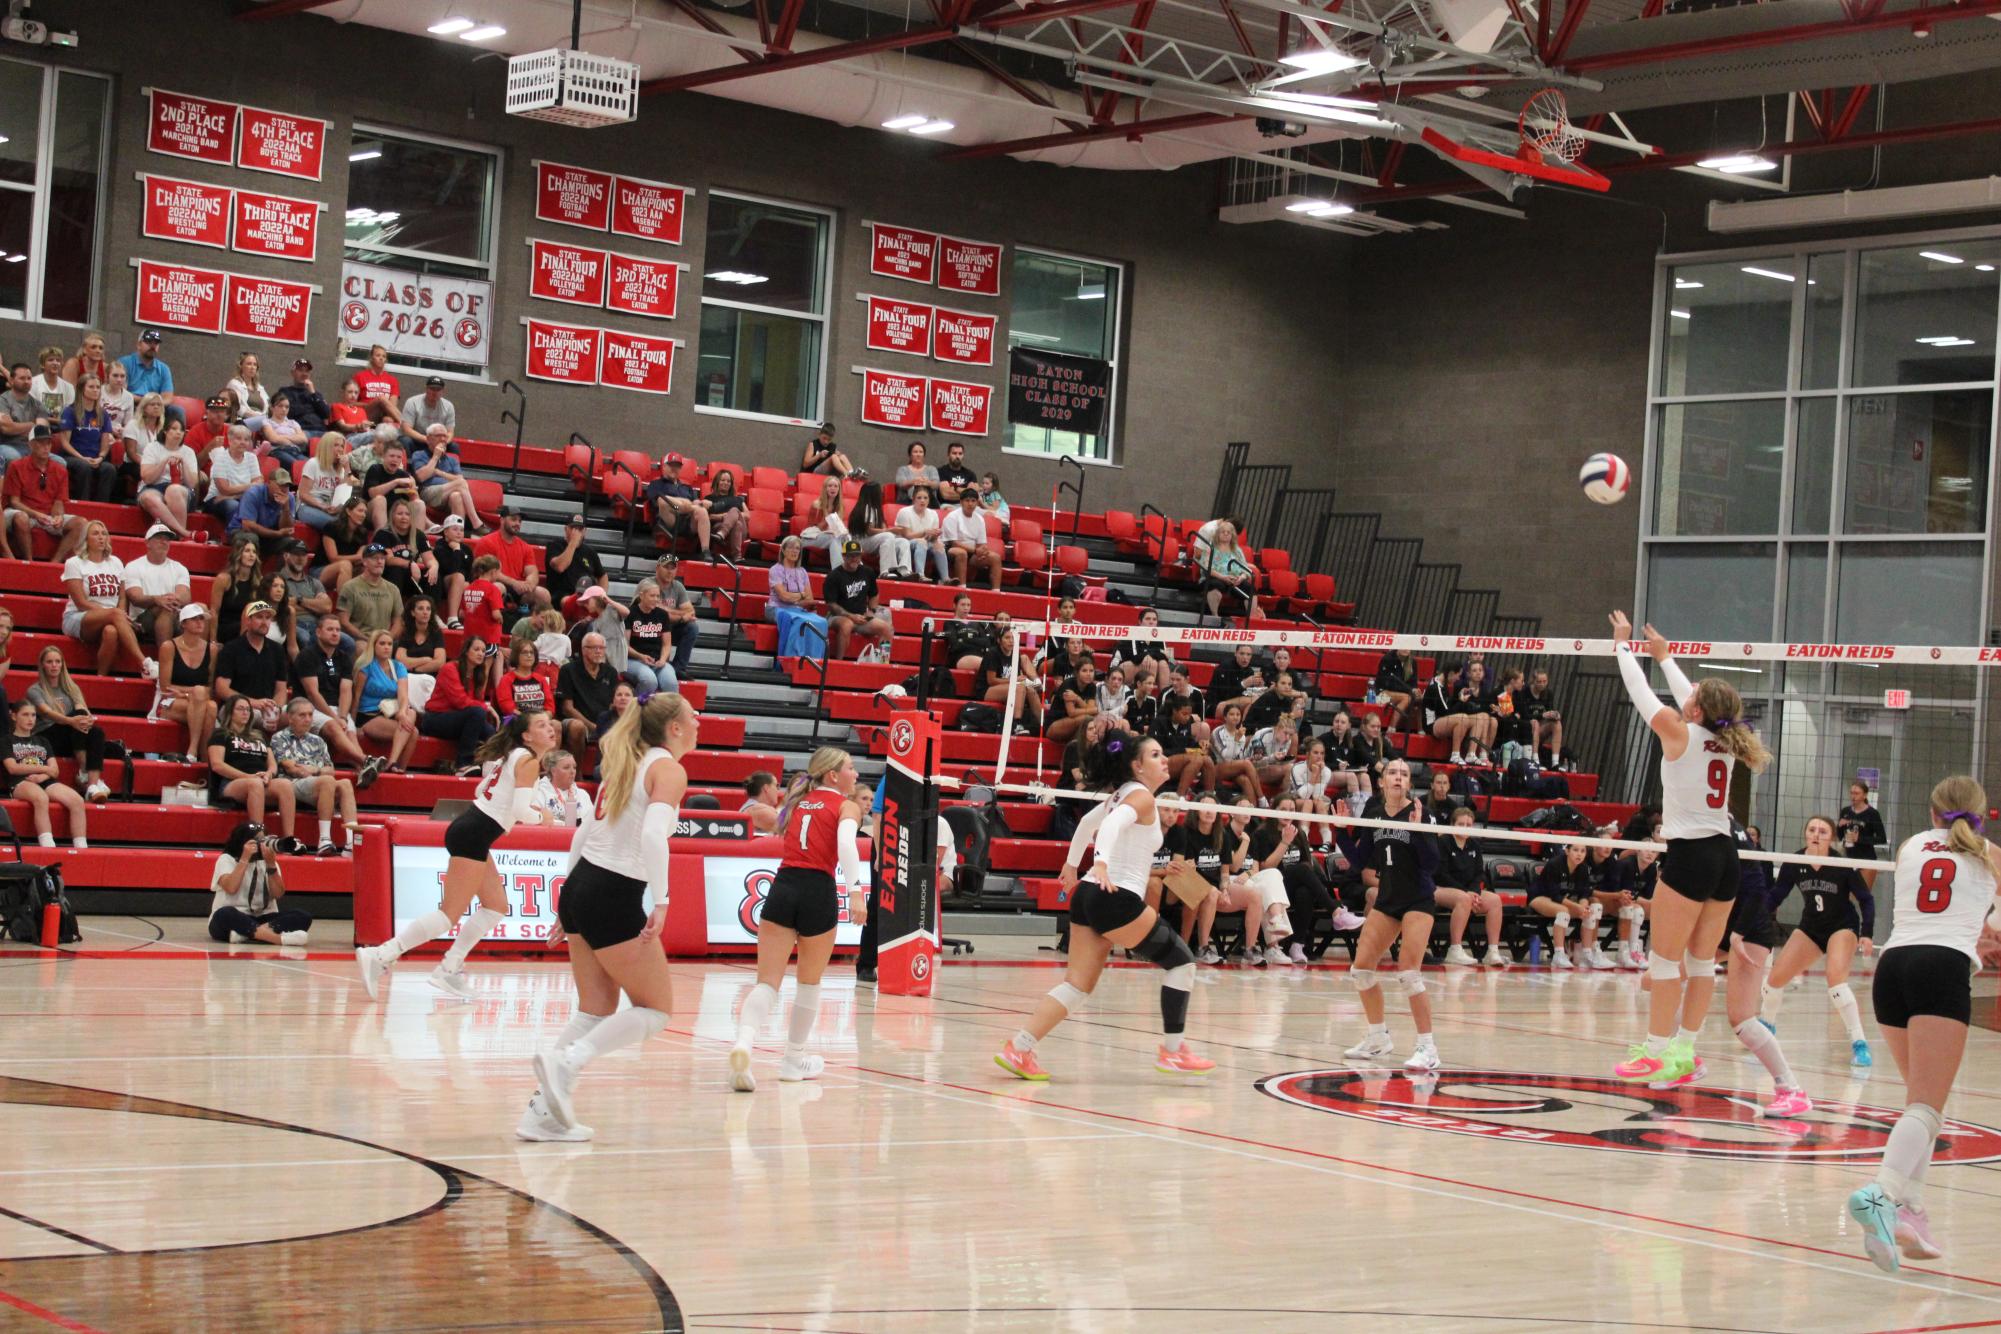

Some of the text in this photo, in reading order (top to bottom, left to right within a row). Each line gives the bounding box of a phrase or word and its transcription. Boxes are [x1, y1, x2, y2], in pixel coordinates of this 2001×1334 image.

[180, 102, 207, 114] STATE
[161, 104, 225, 133] 2ND PLACE
[272, 118, 296, 129] STATE
[176, 123, 207, 137] 2021 AA
[252, 122, 314, 149] 4TH PLACE
[162, 130, 218, 148] MARCHING BAND
[180, 142, 199, 153] EATON
[260, 148, 301, 162] BOYS TRACK
[271, 158, 290, 168] EATON
[565, 172, 588, 183] STATE
[176, 186, 202, 197] STATE
[548, 175, 602, 200] CHAMPIONS
[639, 188, 661, 198] STATE
[156, 188, 221, 216] CHAMPIONS
[266, 201, 291, 212] STATE
[559, 201, 588, 213] FOOTBALL
[622, 189, 675, 214] CHAMPIONS
[244, 203, 311, 230] THIRD PLACE
[565, 210, 582, 219] EATON
[632, 207, 663, 220] 2023 AAA
[168, 217, 207, 230] WRESTLING
[633, 216, 661, 228] BASEBALL
[176, 227, 196, 236] EATON
[639, 225, 654, 234] EATON
[248, 229, 303, 245] MARCHING BAND
[265, 241, 284, 250] EATON
[878, 234, 930, 258] FINAL FOUR
[962, 246, 981, 254] STATE
[559, 250, 581, 261] STATE
[947, 248, 994, 268] CHAMPIONS
[541, 252, 597, 278] FINAL FOUR
[633, 264, 654, 273] STATE
[896, 265, 909, 273] EATON
[169, 272, 195, 282] STATE
[616, 267, 667, 289] 3RD PLACE
[958, 272, 980, 280] SOFTBALL
[150, 275, 214, 301] CHAMPIONS
[257, 284, 282, 295] STATE
[550, 279, 584, 291] VOLLEYBALL
[625, 283, 656, 295] 2023 AAA
[961, 280, 976, 288] EATON
[344, 276, 483, 315] CLASS OF
[558, 288, 575, 297] EATON
[622, 292, 659, 304] BOYS TRACK
[237, 287, 300, 312] CHAMPIONS
[632, 301, 648, 310] EATON
[163, 304, 197, 316] BASEBALL
[169, 313, 188, 322] EATON
[250, 315, 283, 326] SOFTBALL
[874, 307, 926, 328] FINAL FOUR
[256, 325, 275, 334] EATON
[379, 310, 444, 339] 2026
[939, 319, 989, 340] FINAL FOUR
[553, 329, 575, 340] STATE
[886, 330, 913, 340] VOLLEYBALL
[535, 332, 591, 355] CHAMPIONS
[631, 341, 647, 350] STATE
[952, 342, 976, 351] WRESTLING
[546, 349, 578, 361] 2023 AAA
[608, 343, 666, 366] FINAL FOUR
[545, 359, 578, 370] WRESTLING
[552, 368, 569, 377] EATON
[624, 368, 648, 377] FOOTBALL
[1037, 364, 1083, 380] EATON
[628, 376, 643, 384] EATON
[887, 378, 906, 387] STATE
[1011, 374, 1105, 398] HIGH SCHOOL
[871, 380, 919, 402] CHAMPIONS
[951, 386, 970, 394] STATE
[880, 397, 908, 408] 2024 AAA
[935, 389, 983, 410] FINAL FOUR
[1025, 390, 1090, 409] CLASS OF
[881, 406, 906, 415] BASEBALL
[945, 404, 973, 415] 2024 AAA
[1041, 406, 1072, 420] 2029
[959, 415, 974, 423] TRACK
[1061, 625, 1129, 637] EATON REDS
[1181, 630, 1256, 641] EATON REDS
[1313, 633, 1393, 645] EATON REDS
[1456, 637, 1545, 650] EATON REDS
[1668, 643, 1712, 654] REDS
[1786, 645, 1895, 659] EATON REDS
[1888, 690, 1905, 707] EXIT
[1706, 759, 1727, 808] 9
[798, 801, 824, 810] Reds
[800, 814, 811, 850] 1
[496, 854, 558, 867] Welcome to
[880, 799, 899, 914] EATON
[898, 824, 909, 888] REDS
[1385, 845, 1393, 866] 1
[1917, 858, 1957, 913] 8
[1814, 894, 1824, 912] 9
